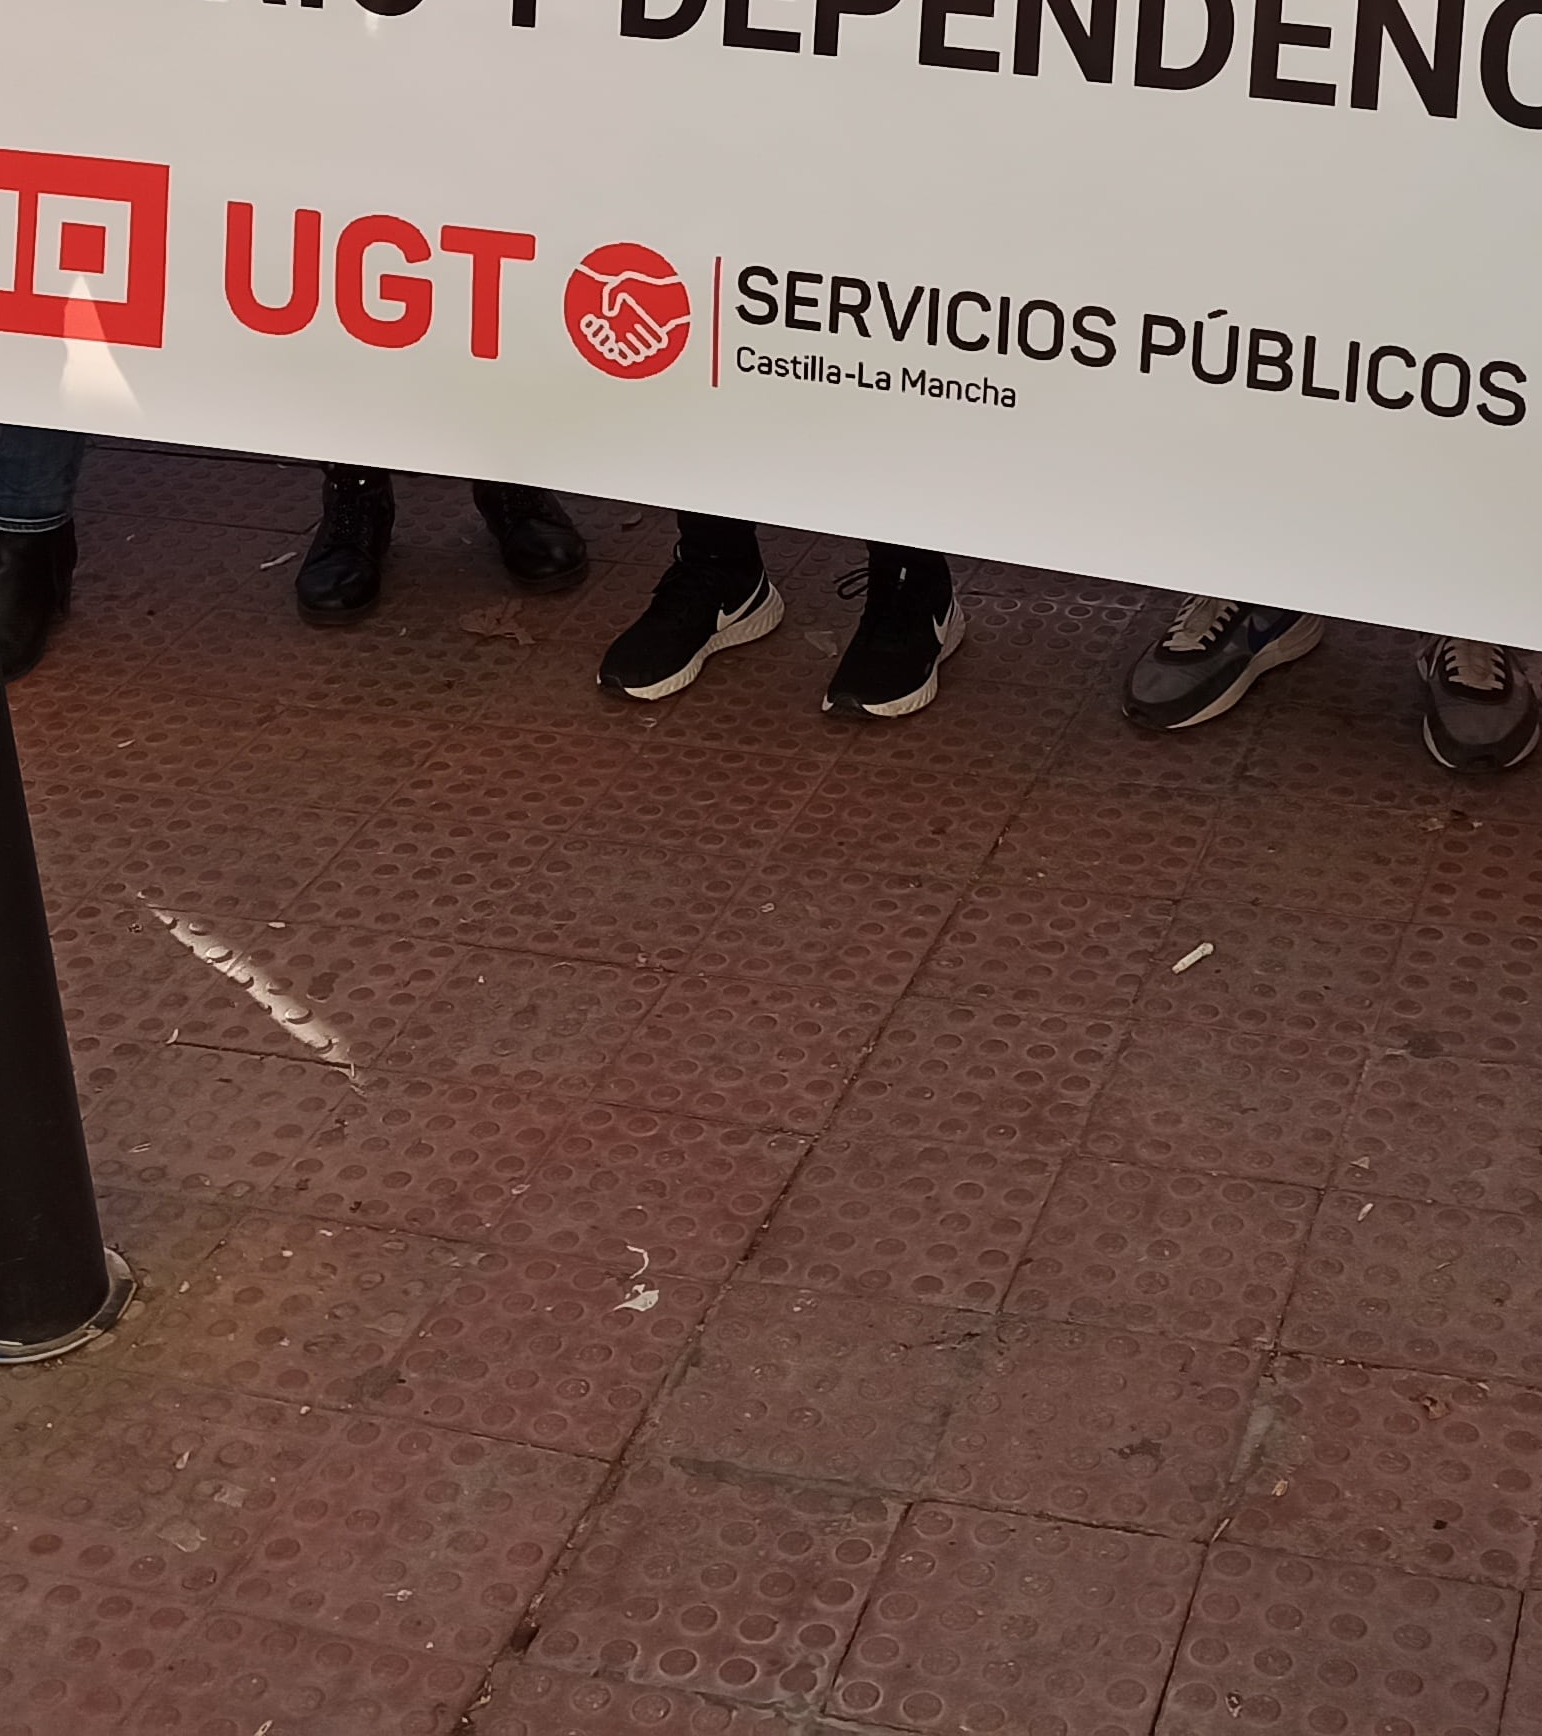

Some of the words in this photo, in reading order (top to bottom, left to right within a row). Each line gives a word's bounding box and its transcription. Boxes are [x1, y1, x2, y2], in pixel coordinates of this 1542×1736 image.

[224, 199, 536, 360] UGT
[734, 264, 1117, 368] SERVICIOS
[1139, 307, 1529, 427] PÚBLICOS
[734, 345, 892, 393] Castilla-La
[900, 373, 1018, 410] Mancha
